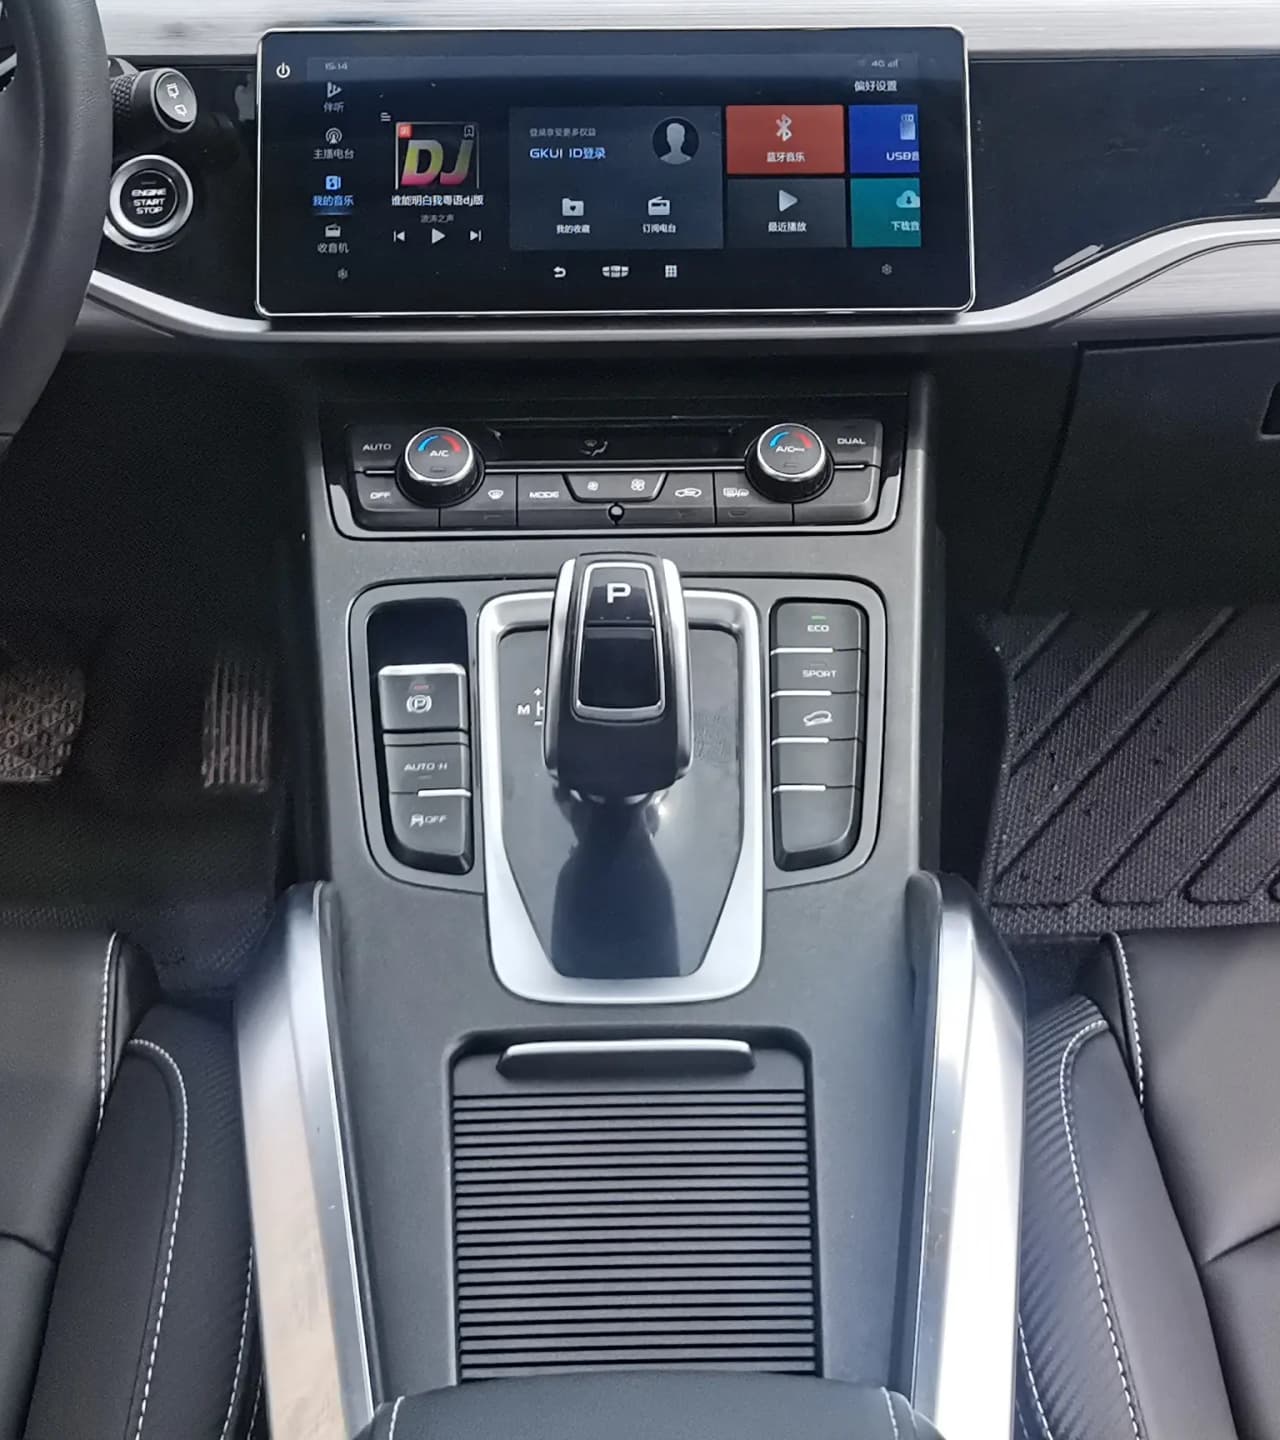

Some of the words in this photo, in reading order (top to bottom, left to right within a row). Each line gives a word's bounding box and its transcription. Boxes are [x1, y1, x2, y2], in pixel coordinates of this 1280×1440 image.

[854, 80, 897, 92] 偏好设置
[313, 149, 355, 160] 主播电台
[529, 147, 563, 159] GKUI
[569, 147, 606, 160] ID登录
[767, 152, 806, 162] 蓝牙音乐
[400, 139, 475, 185] DJ
[131, 188, 166, 197] ENGINE
[133, 198, 165, 207] START
[312, 195, 354, 207] 我的音乐
[136, 207, 163, 215] STOP
[768, 221, 807, 232] 最近播放
[317, 243, 350, 254] 收音机
[362, 443, 392, 452] AUTO
[370, 491, 391, 500] OFF
[529, 491, 560, 499] MODE
[606, 583, 631, 604] P
[807, 625, 830, 633] ECO
[802, 669, 837, 678] SPORT
[517, 704, 530, 715] M
[404, 762, 435, 771] AUTO
[425, 814, 447, 824] OFF
